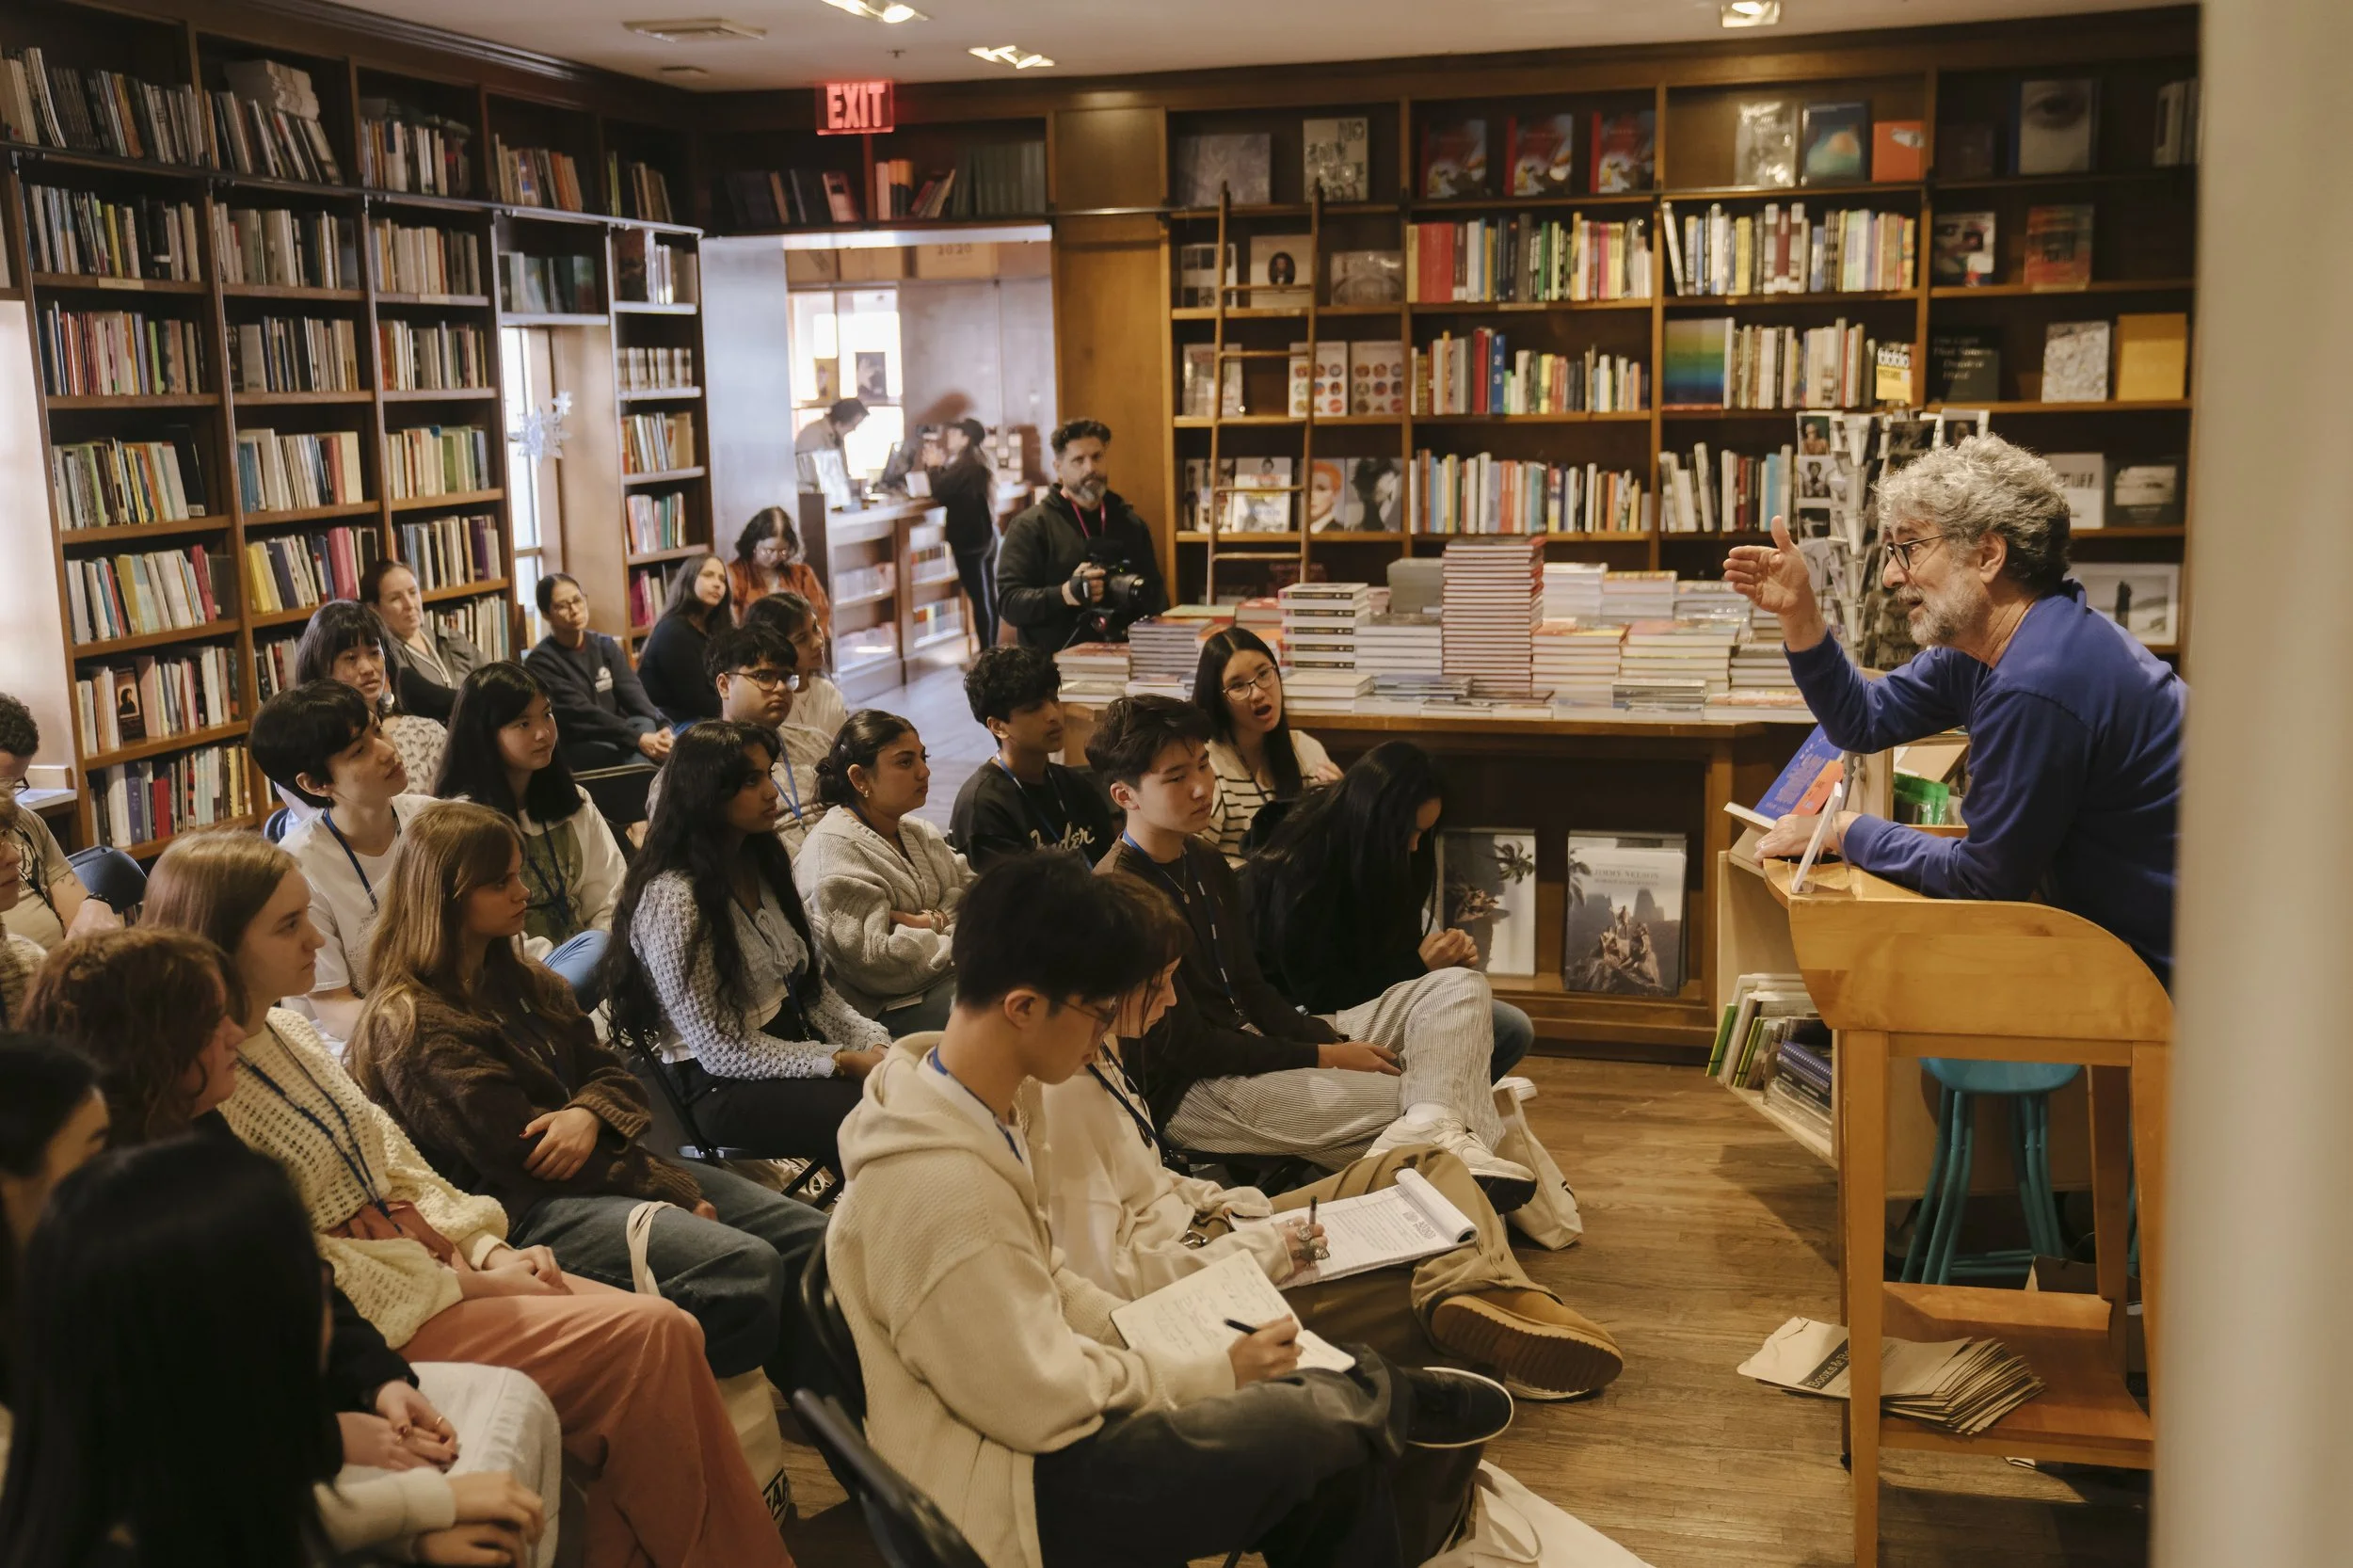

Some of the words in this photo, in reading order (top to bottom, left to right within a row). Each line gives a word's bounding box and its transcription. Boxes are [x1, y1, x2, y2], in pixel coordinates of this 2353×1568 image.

[826, 81, 886, 129] EXIT
[2057, 472, 2094, 488] TUFF
[1031, 821, 1096, 852] Fder
[1593, 869, 1621, 877] JIMMY
